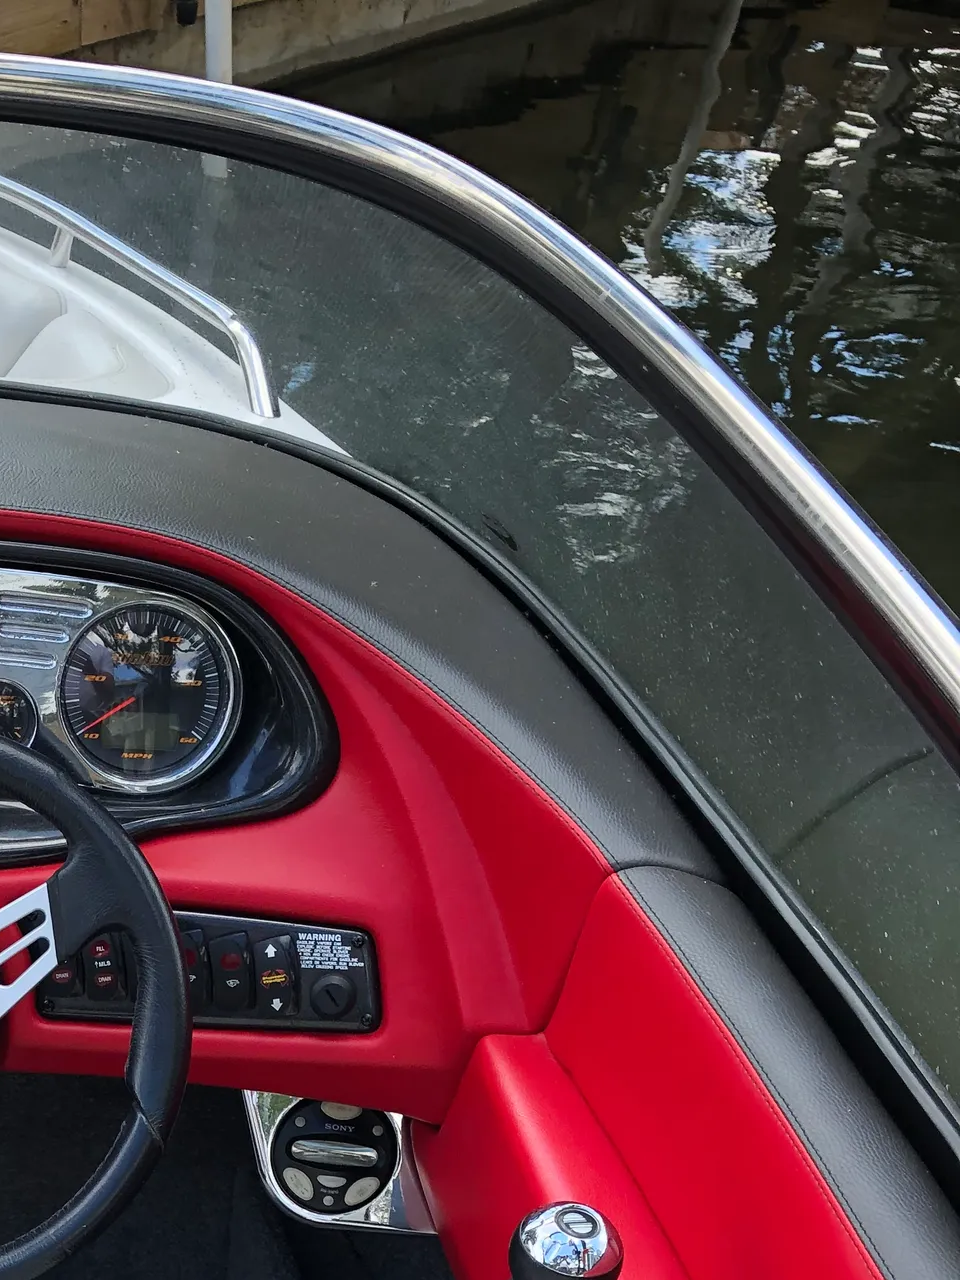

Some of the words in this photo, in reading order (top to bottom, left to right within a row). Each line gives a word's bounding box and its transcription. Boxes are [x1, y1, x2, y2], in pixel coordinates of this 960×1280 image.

[84, 674, 106, 682] 20
[298, 933, 341, 941] WARNING
[324, 1122, 356, 1133] SONY
